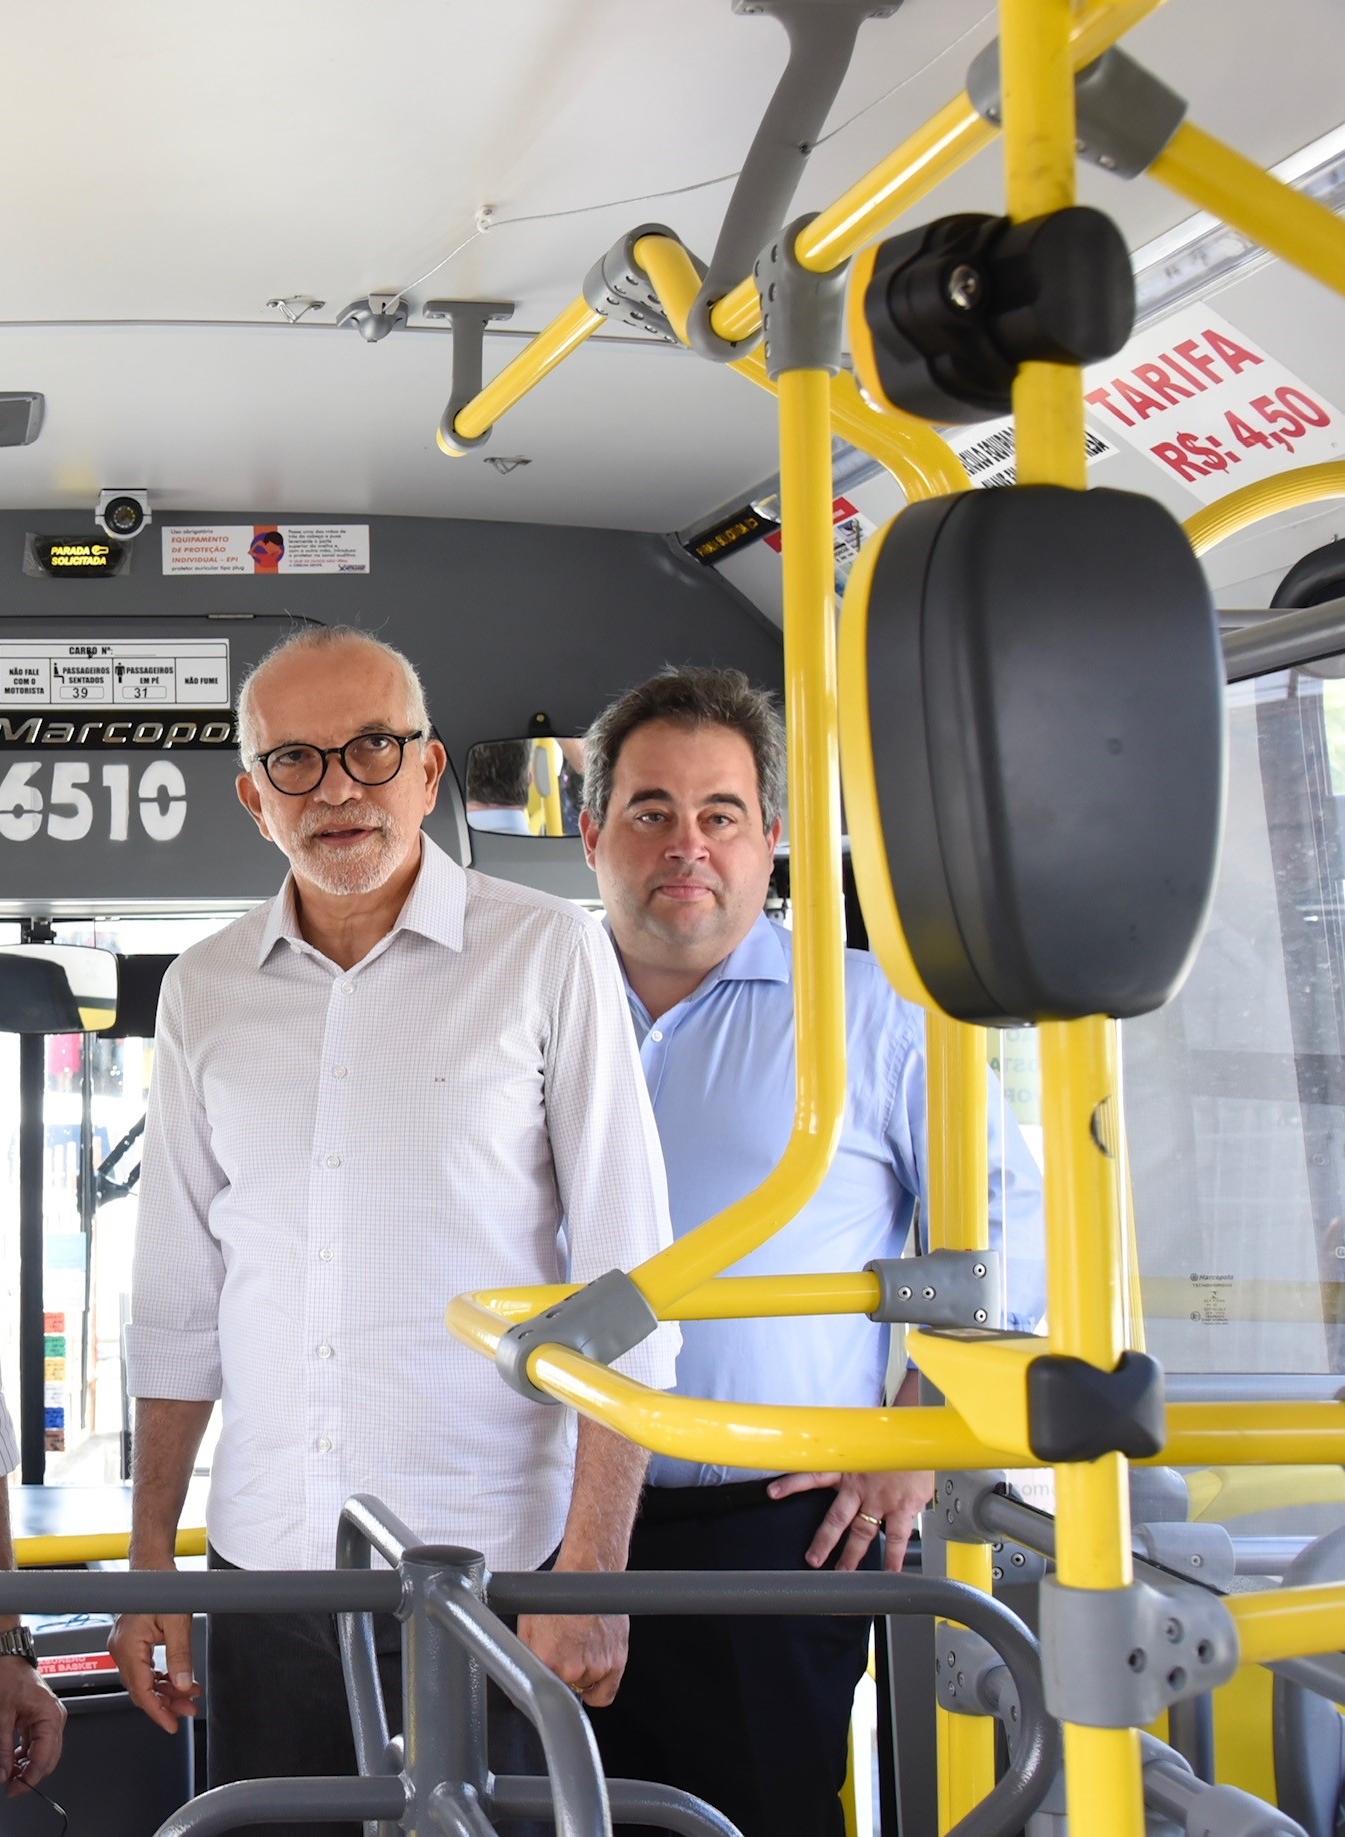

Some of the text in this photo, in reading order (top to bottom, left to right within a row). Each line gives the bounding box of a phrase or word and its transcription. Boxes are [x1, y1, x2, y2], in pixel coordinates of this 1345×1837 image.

[1083, 329, 1265, 427] TARIFA
[1224, 386, 1331, 454] 4,50
[51, 546, 90, 555] PARADA
[184, 546, 226, 554] PROTEÇÃO
[51, 556, 106, 566] SOLICITADA
[9, 667, 23, 676] NÃO
[72, 687, 88, 698] 39
[134, 688, 147, 698] 31
[58, 1661, 98, 1672] BASKET
